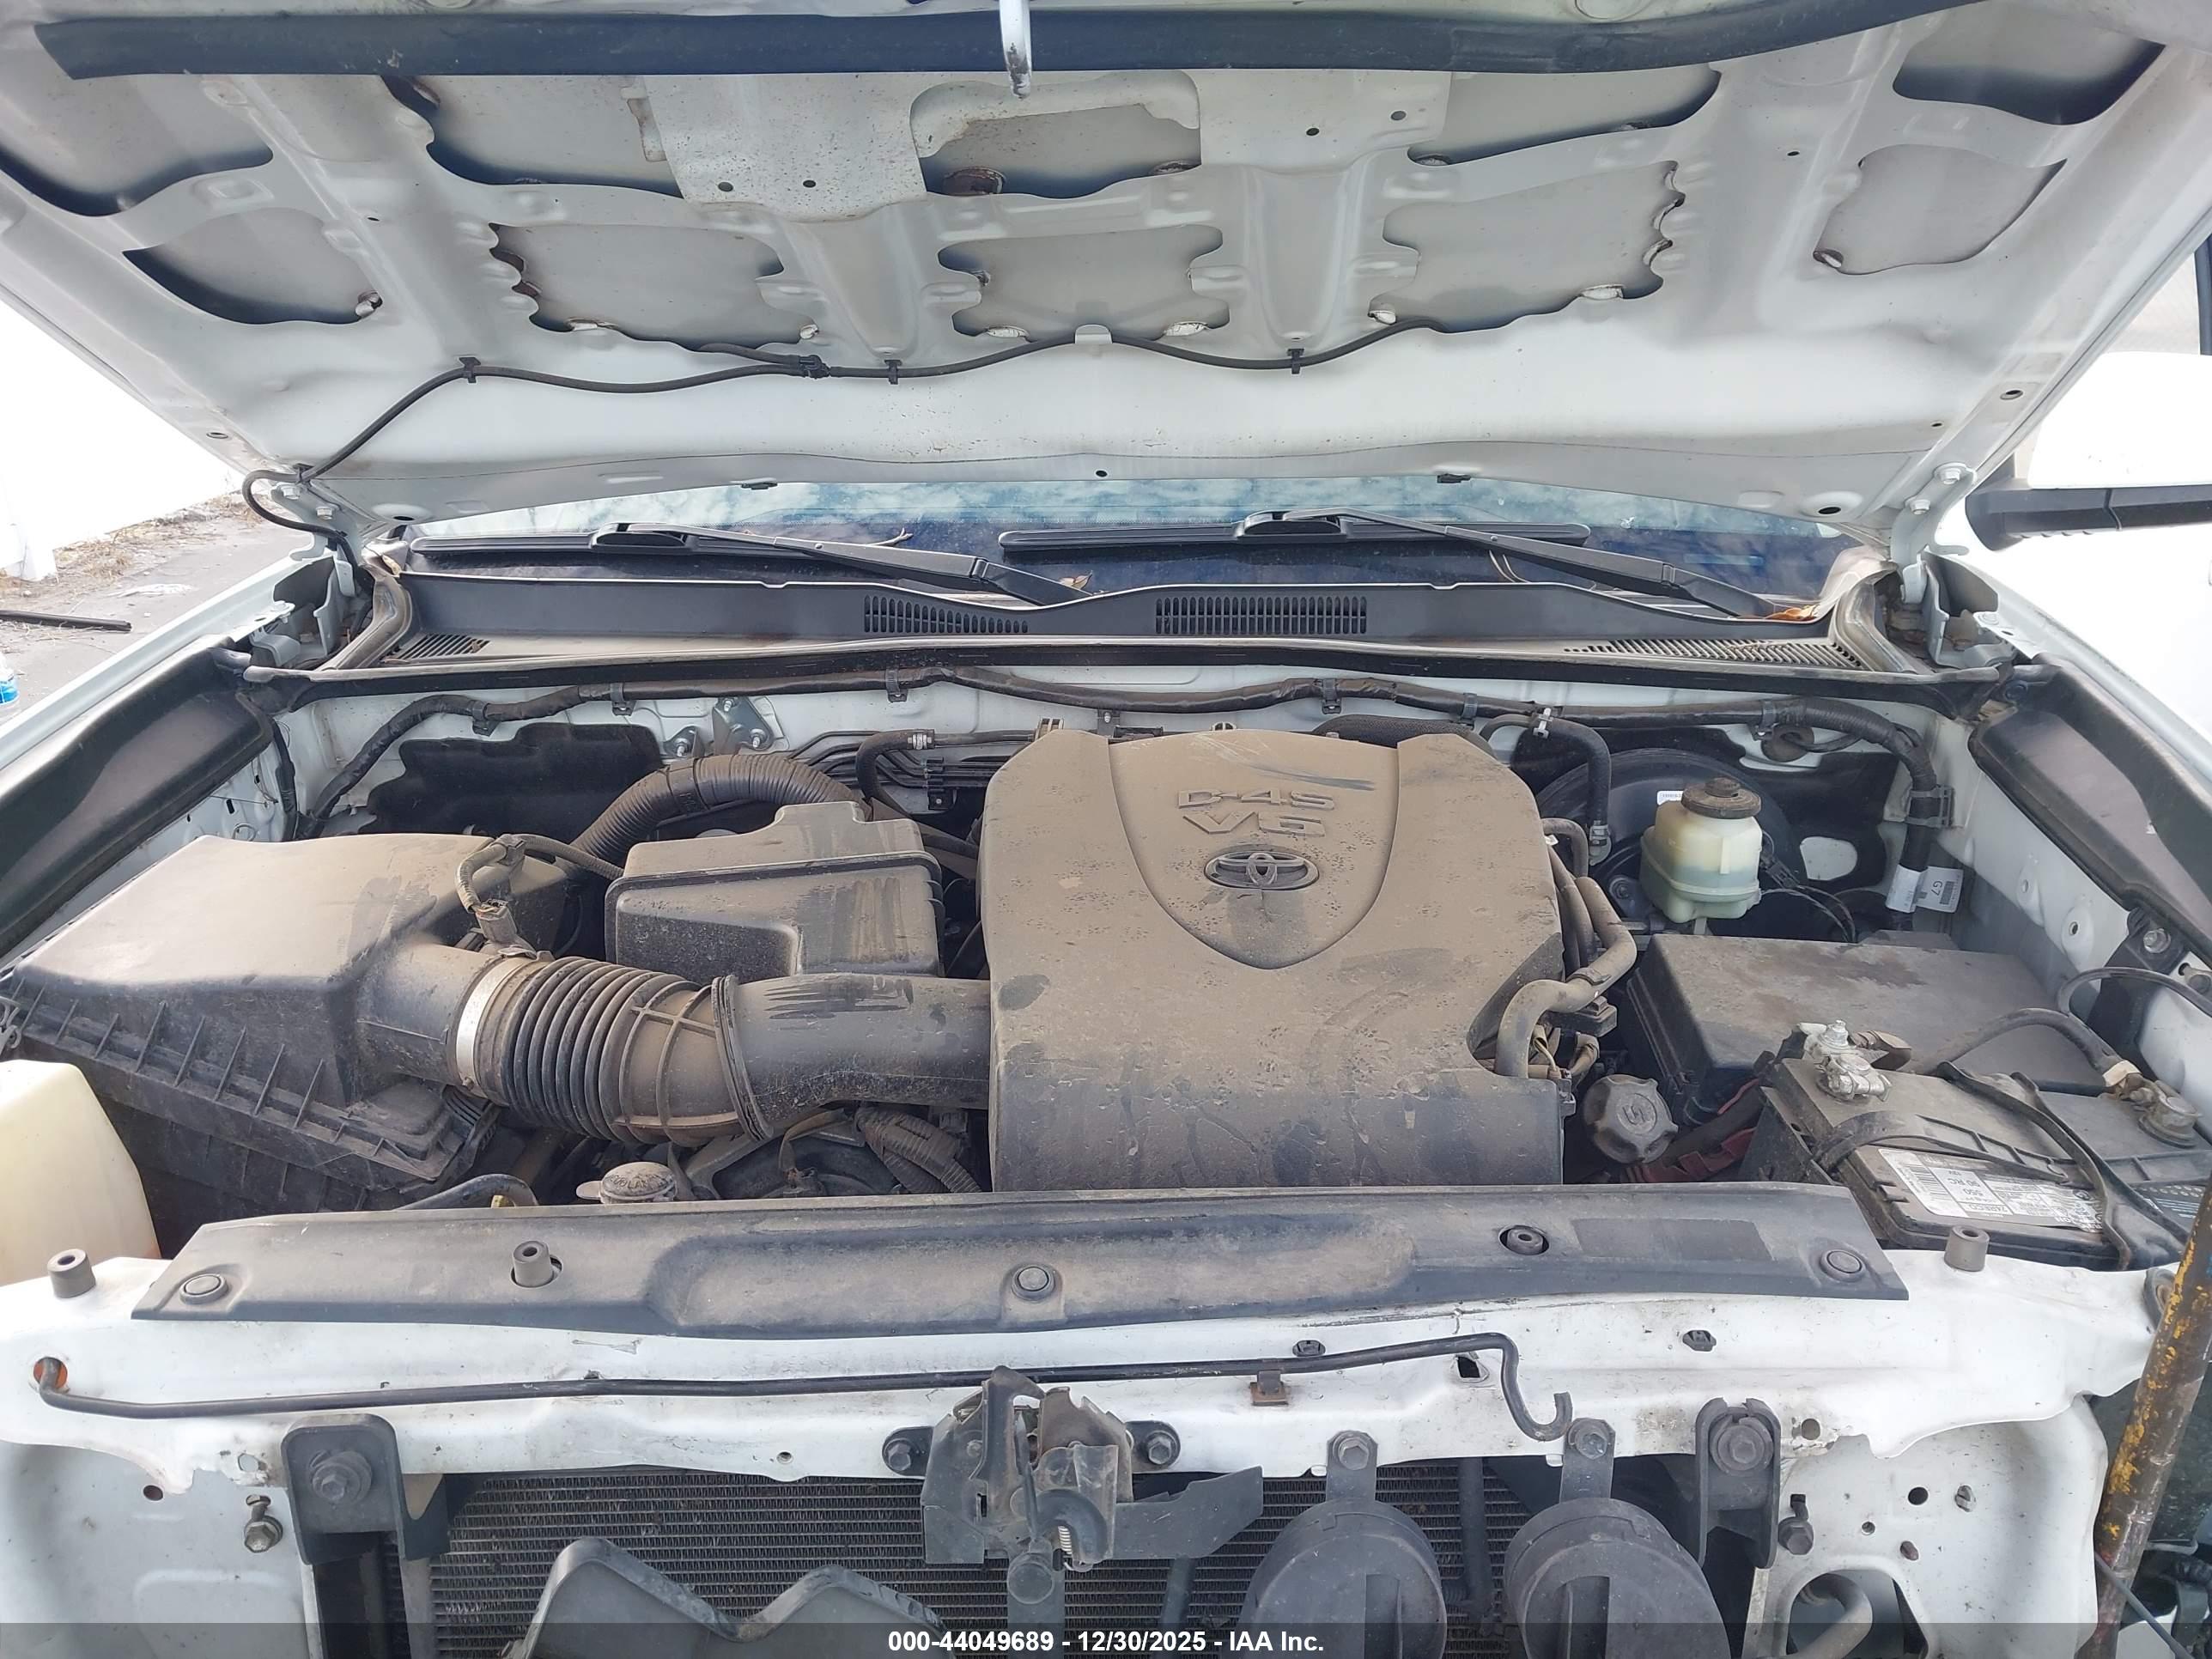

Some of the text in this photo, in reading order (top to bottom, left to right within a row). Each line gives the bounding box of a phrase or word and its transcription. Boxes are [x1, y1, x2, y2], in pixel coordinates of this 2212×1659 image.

[1177, 789, 1335, 811] D-4S
[1182, 811, 1327, 837] V6
[1930, 880, 1943, 896] G7
